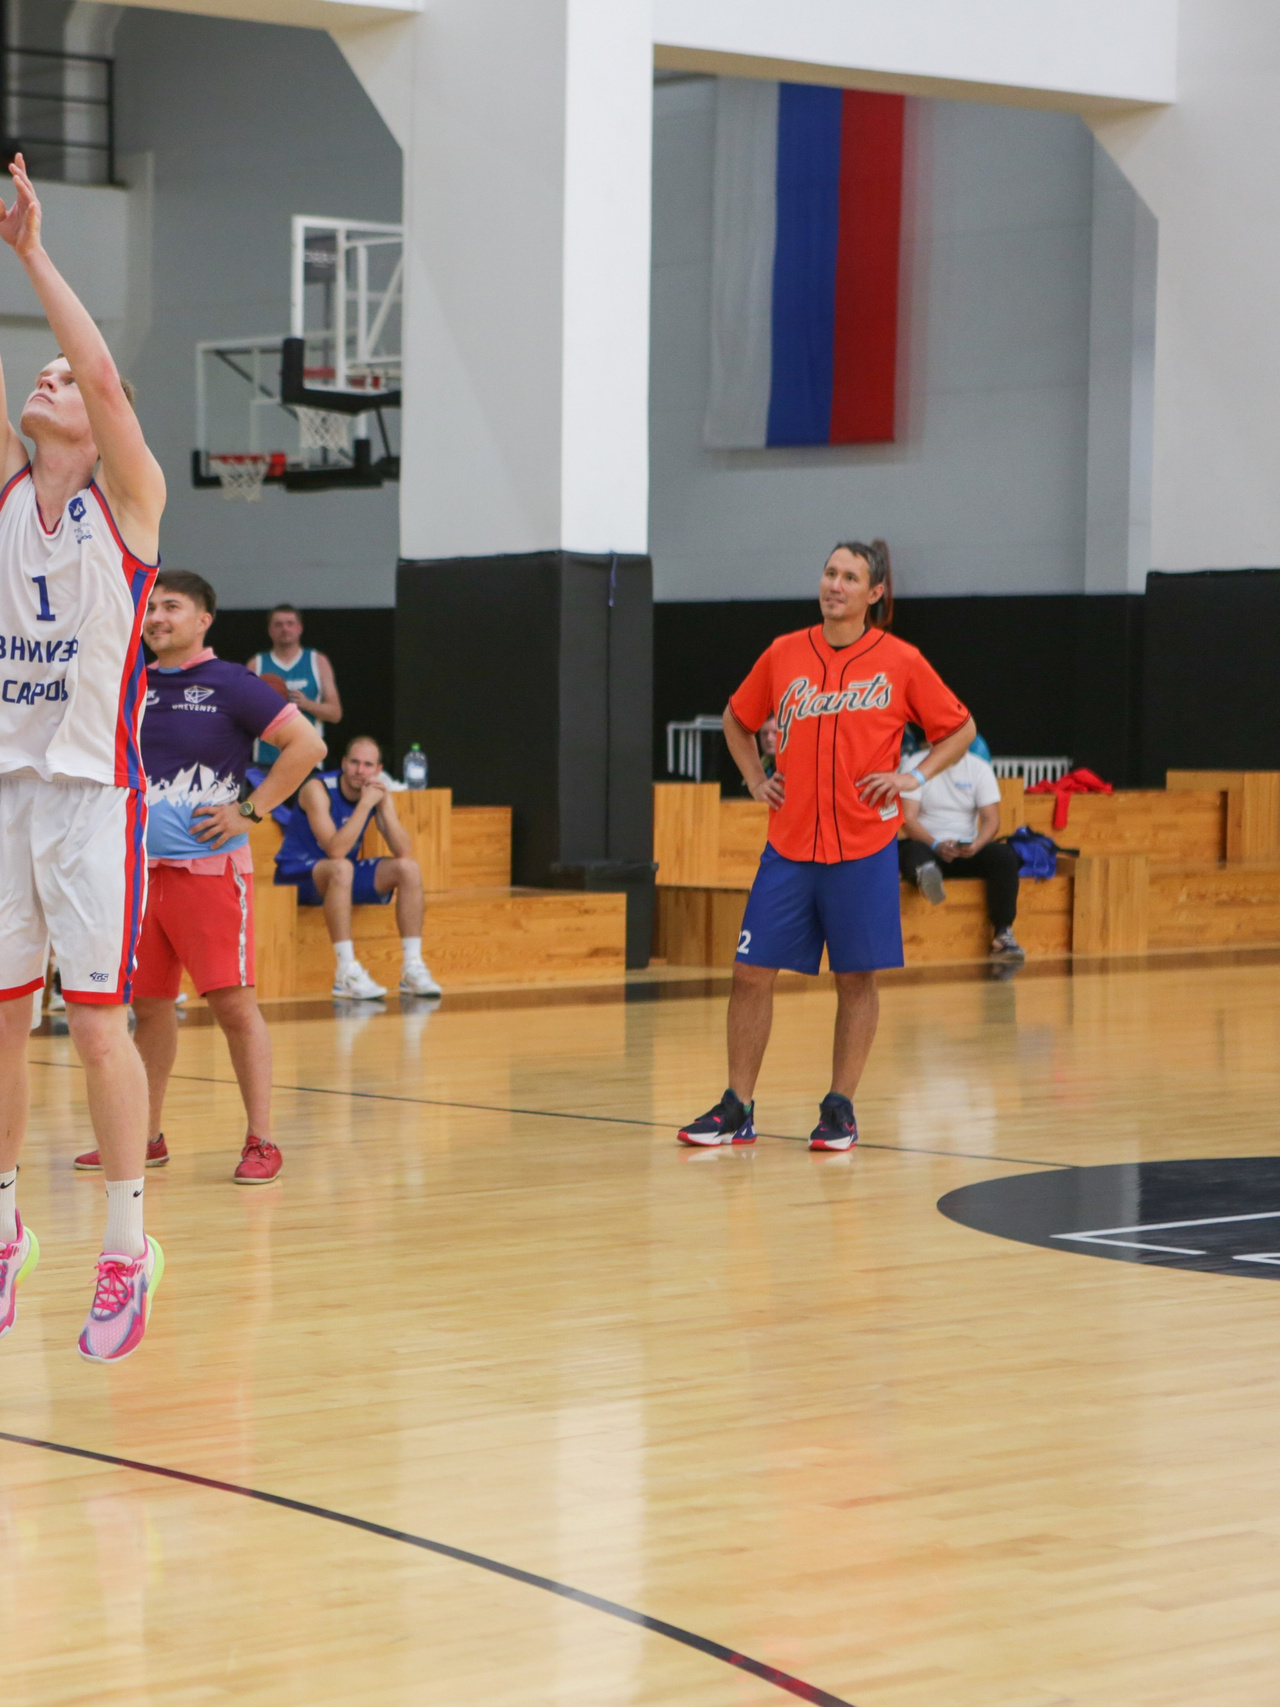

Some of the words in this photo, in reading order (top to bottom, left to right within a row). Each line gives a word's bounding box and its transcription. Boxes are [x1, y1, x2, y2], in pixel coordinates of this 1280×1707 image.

[32, 575, 56, 621] 1
[777, 672, 892, 754] Giants
[736, 929, 752, 955] 2
